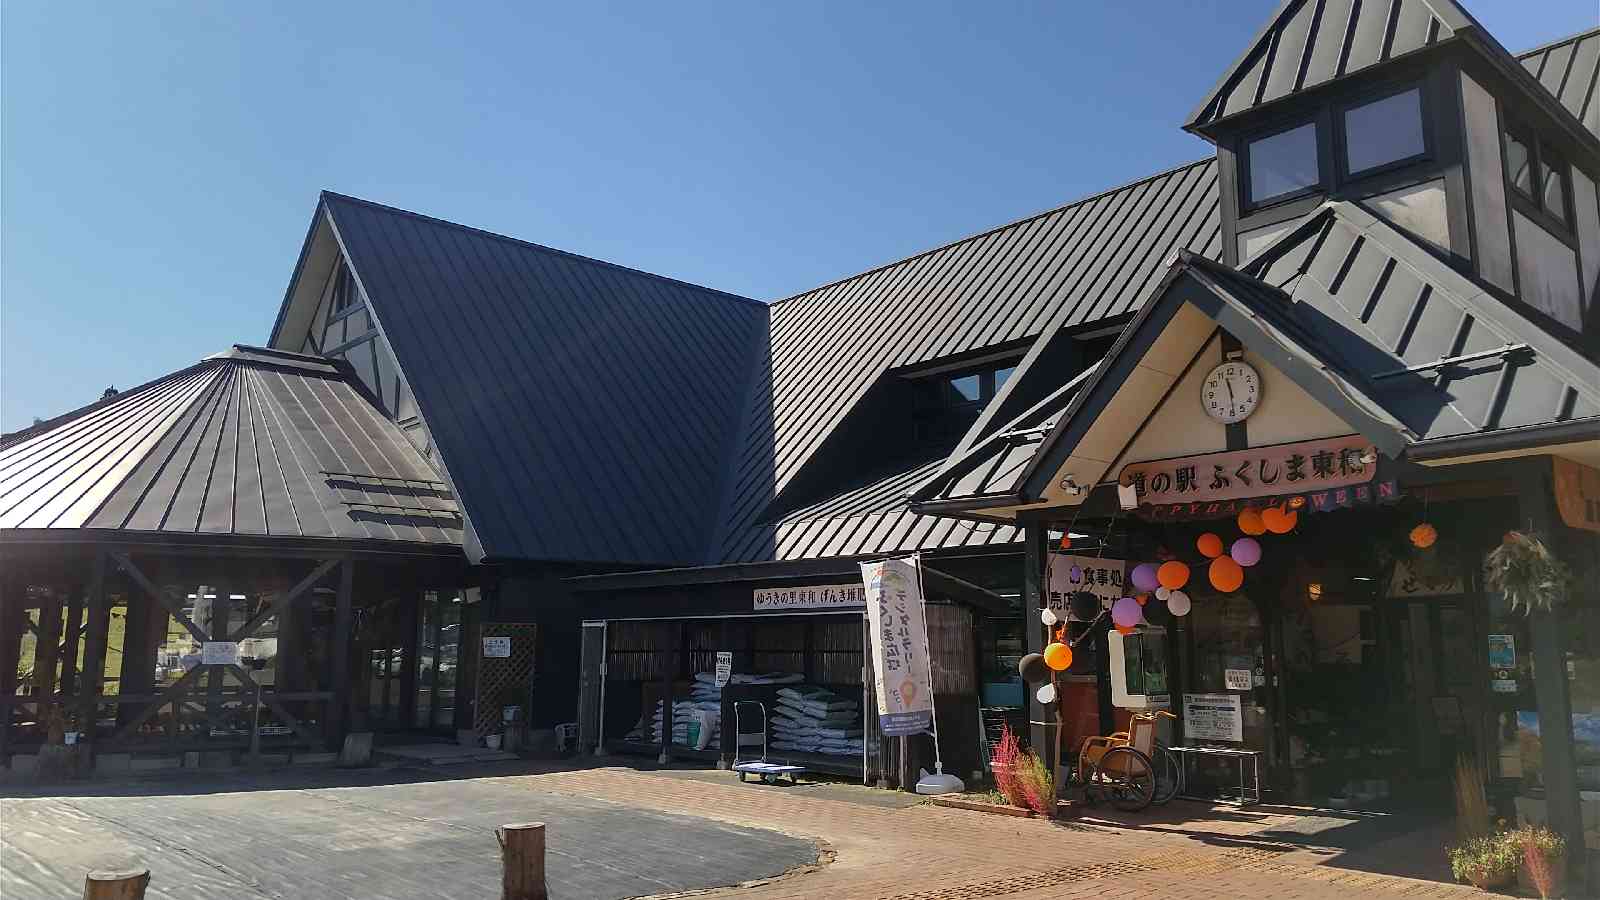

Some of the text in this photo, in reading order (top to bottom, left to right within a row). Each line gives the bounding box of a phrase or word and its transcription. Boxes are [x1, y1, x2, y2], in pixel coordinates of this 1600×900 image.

[1217, 371, 1224, 381] 11
[1226, 367, 1234, 376] 12
[1207, 379, 1218, 389] 10
[1246, 374, 1252, 384] 2
[1248, 384, 1255, 393] 3
[1208, 390, 1215, 400] 9
[1211, 400, 1217, 409] 8
[1239, 404, 1246, 413] 5
[1127, 464, 1198, 498] 道の駅
